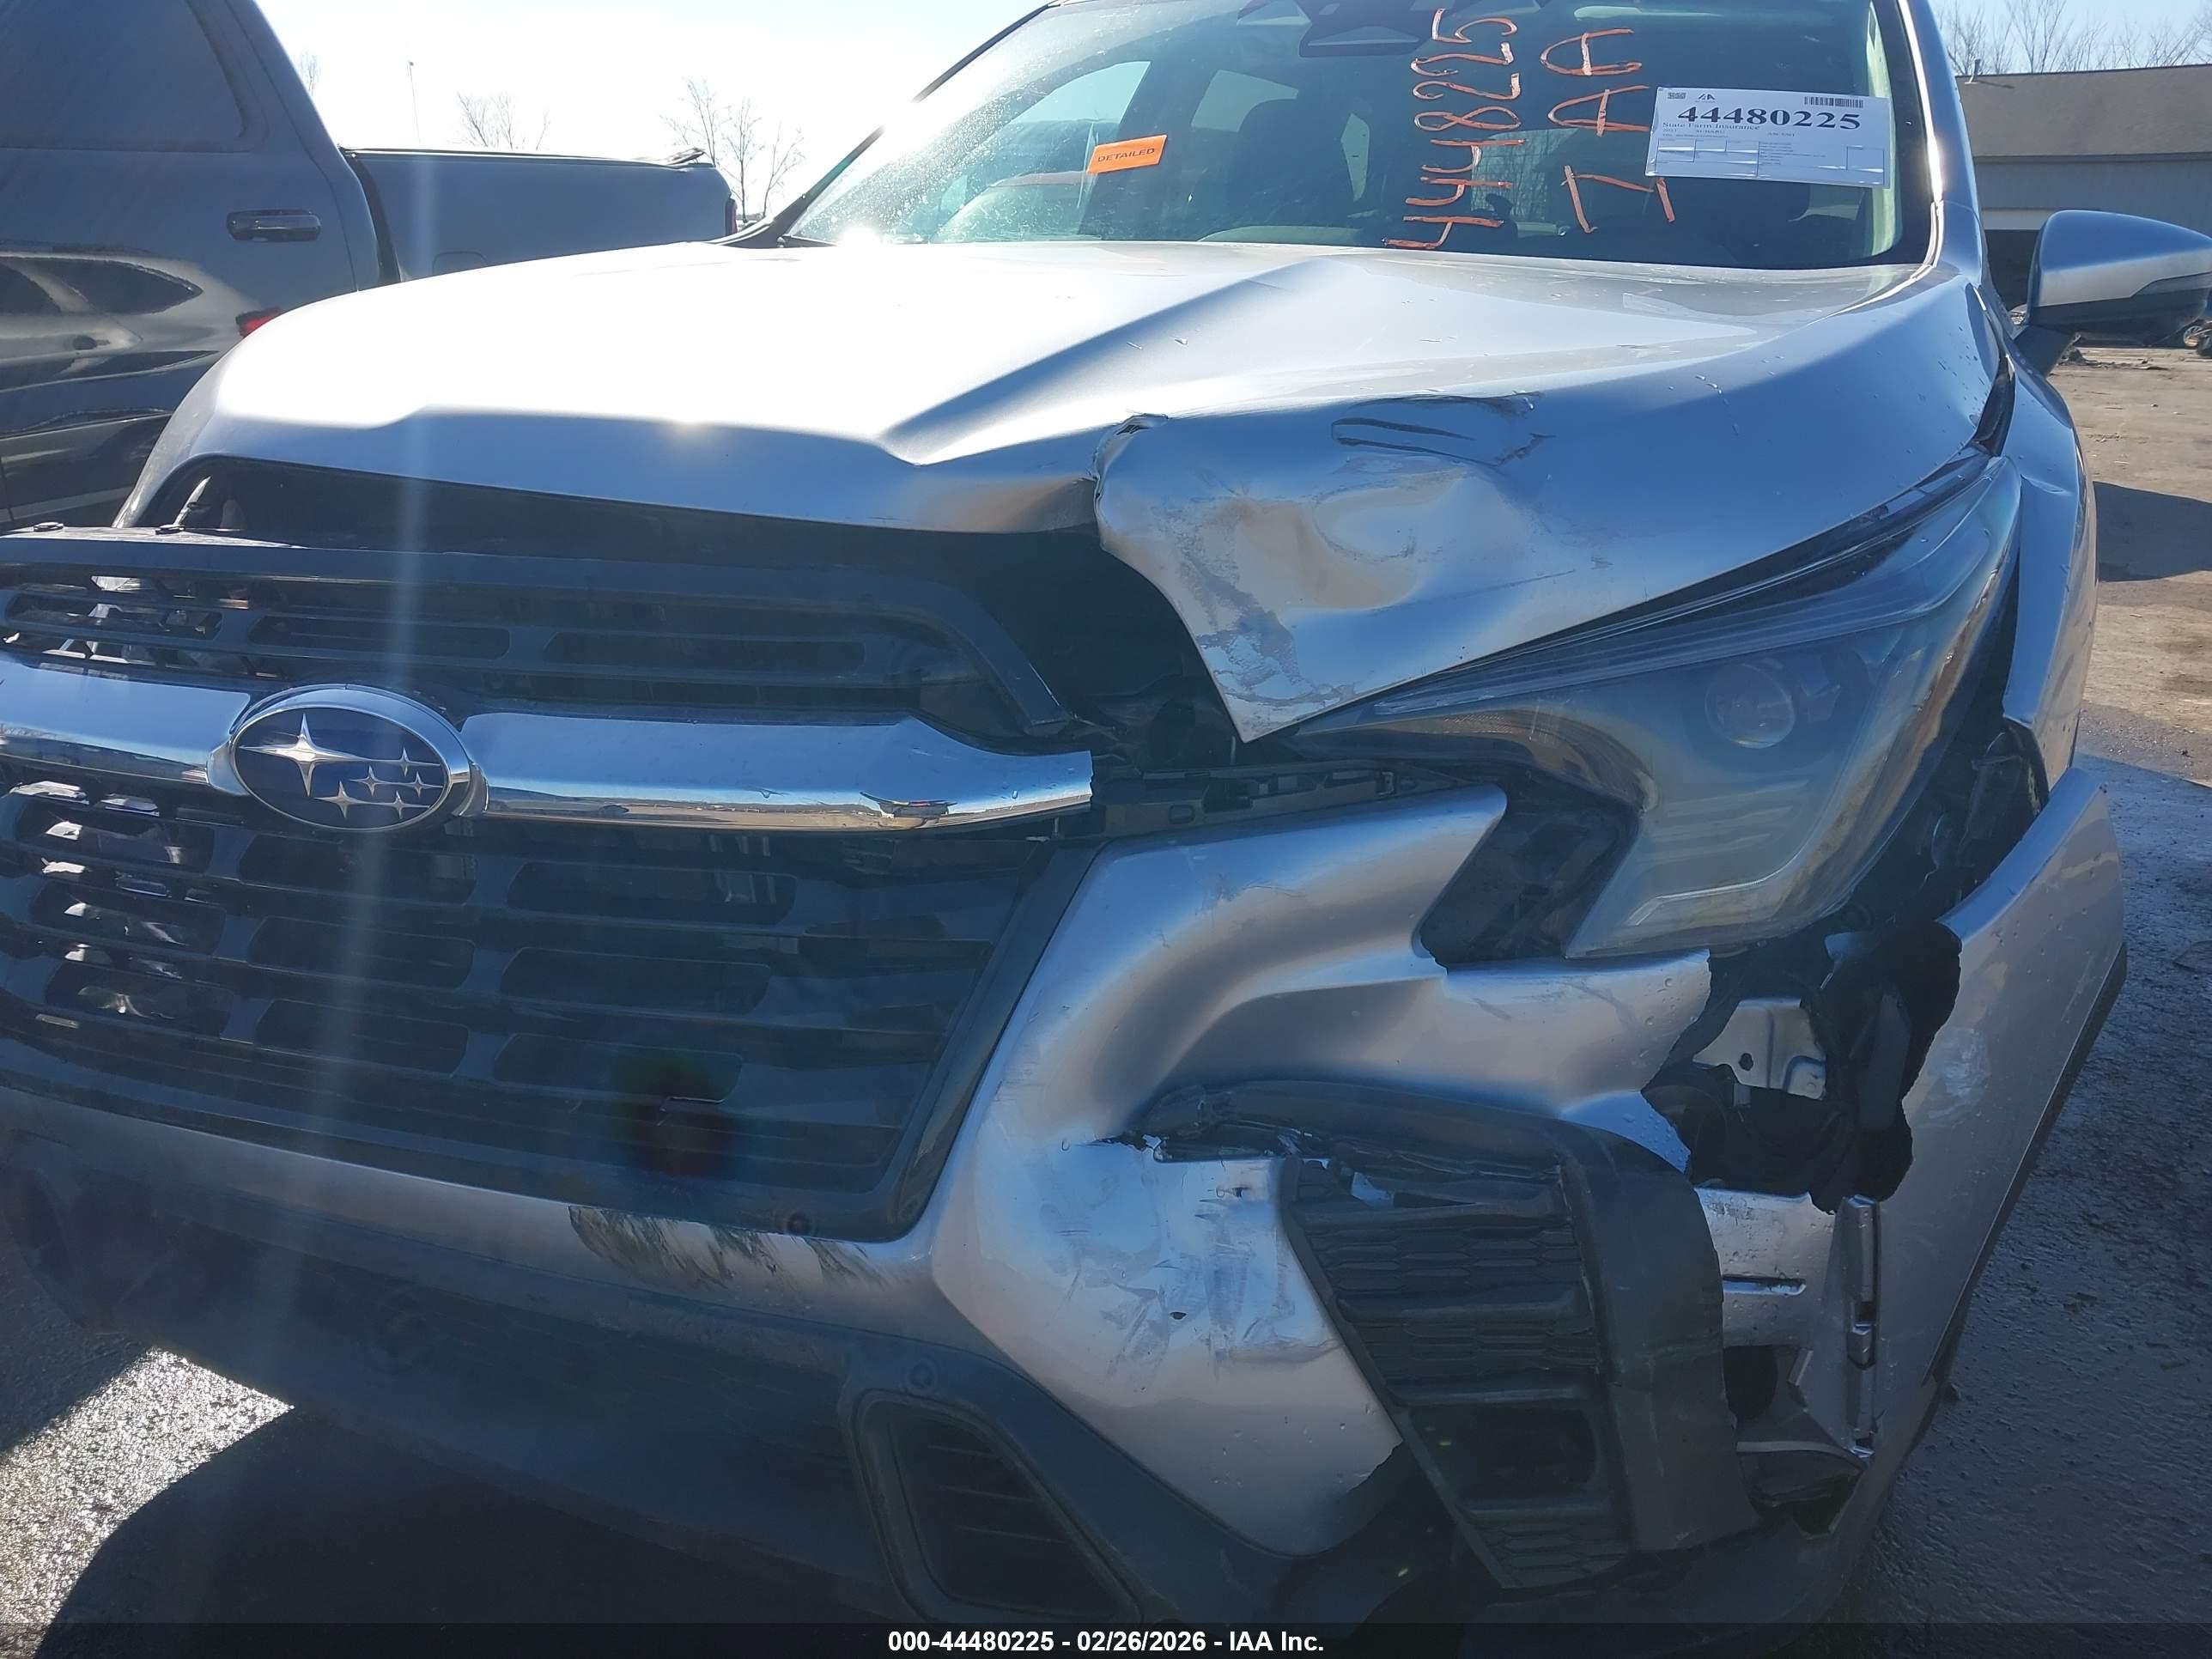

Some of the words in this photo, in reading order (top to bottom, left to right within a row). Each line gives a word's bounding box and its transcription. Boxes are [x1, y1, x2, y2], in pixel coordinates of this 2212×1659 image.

[1382, 8, 1526, 249] 4448225
[1677, 106, 1861, 130] 44480225
[1097, 148, 1155, 162] DETAILED
